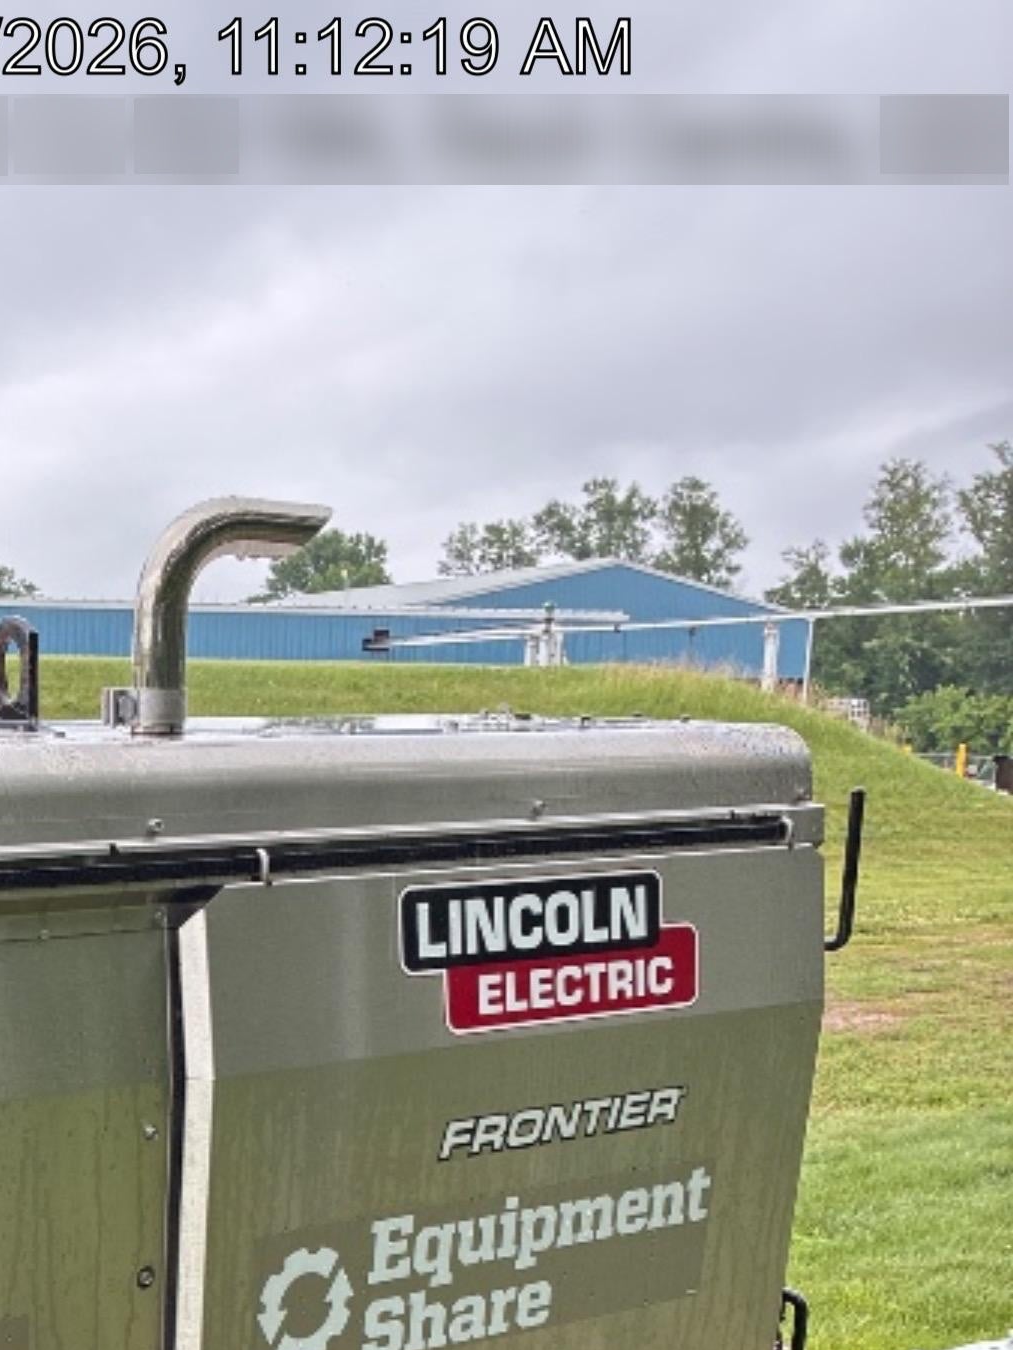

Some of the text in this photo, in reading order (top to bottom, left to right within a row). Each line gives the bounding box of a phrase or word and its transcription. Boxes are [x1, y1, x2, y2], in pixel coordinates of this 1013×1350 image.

[416, 885, 648, 959] LINCOLN
[478, 956, 673, 1016] ELECTRIC
[438, 1086, 687, 1161] FRONTIER
[367, 1167, 711, 1287] Equipment
